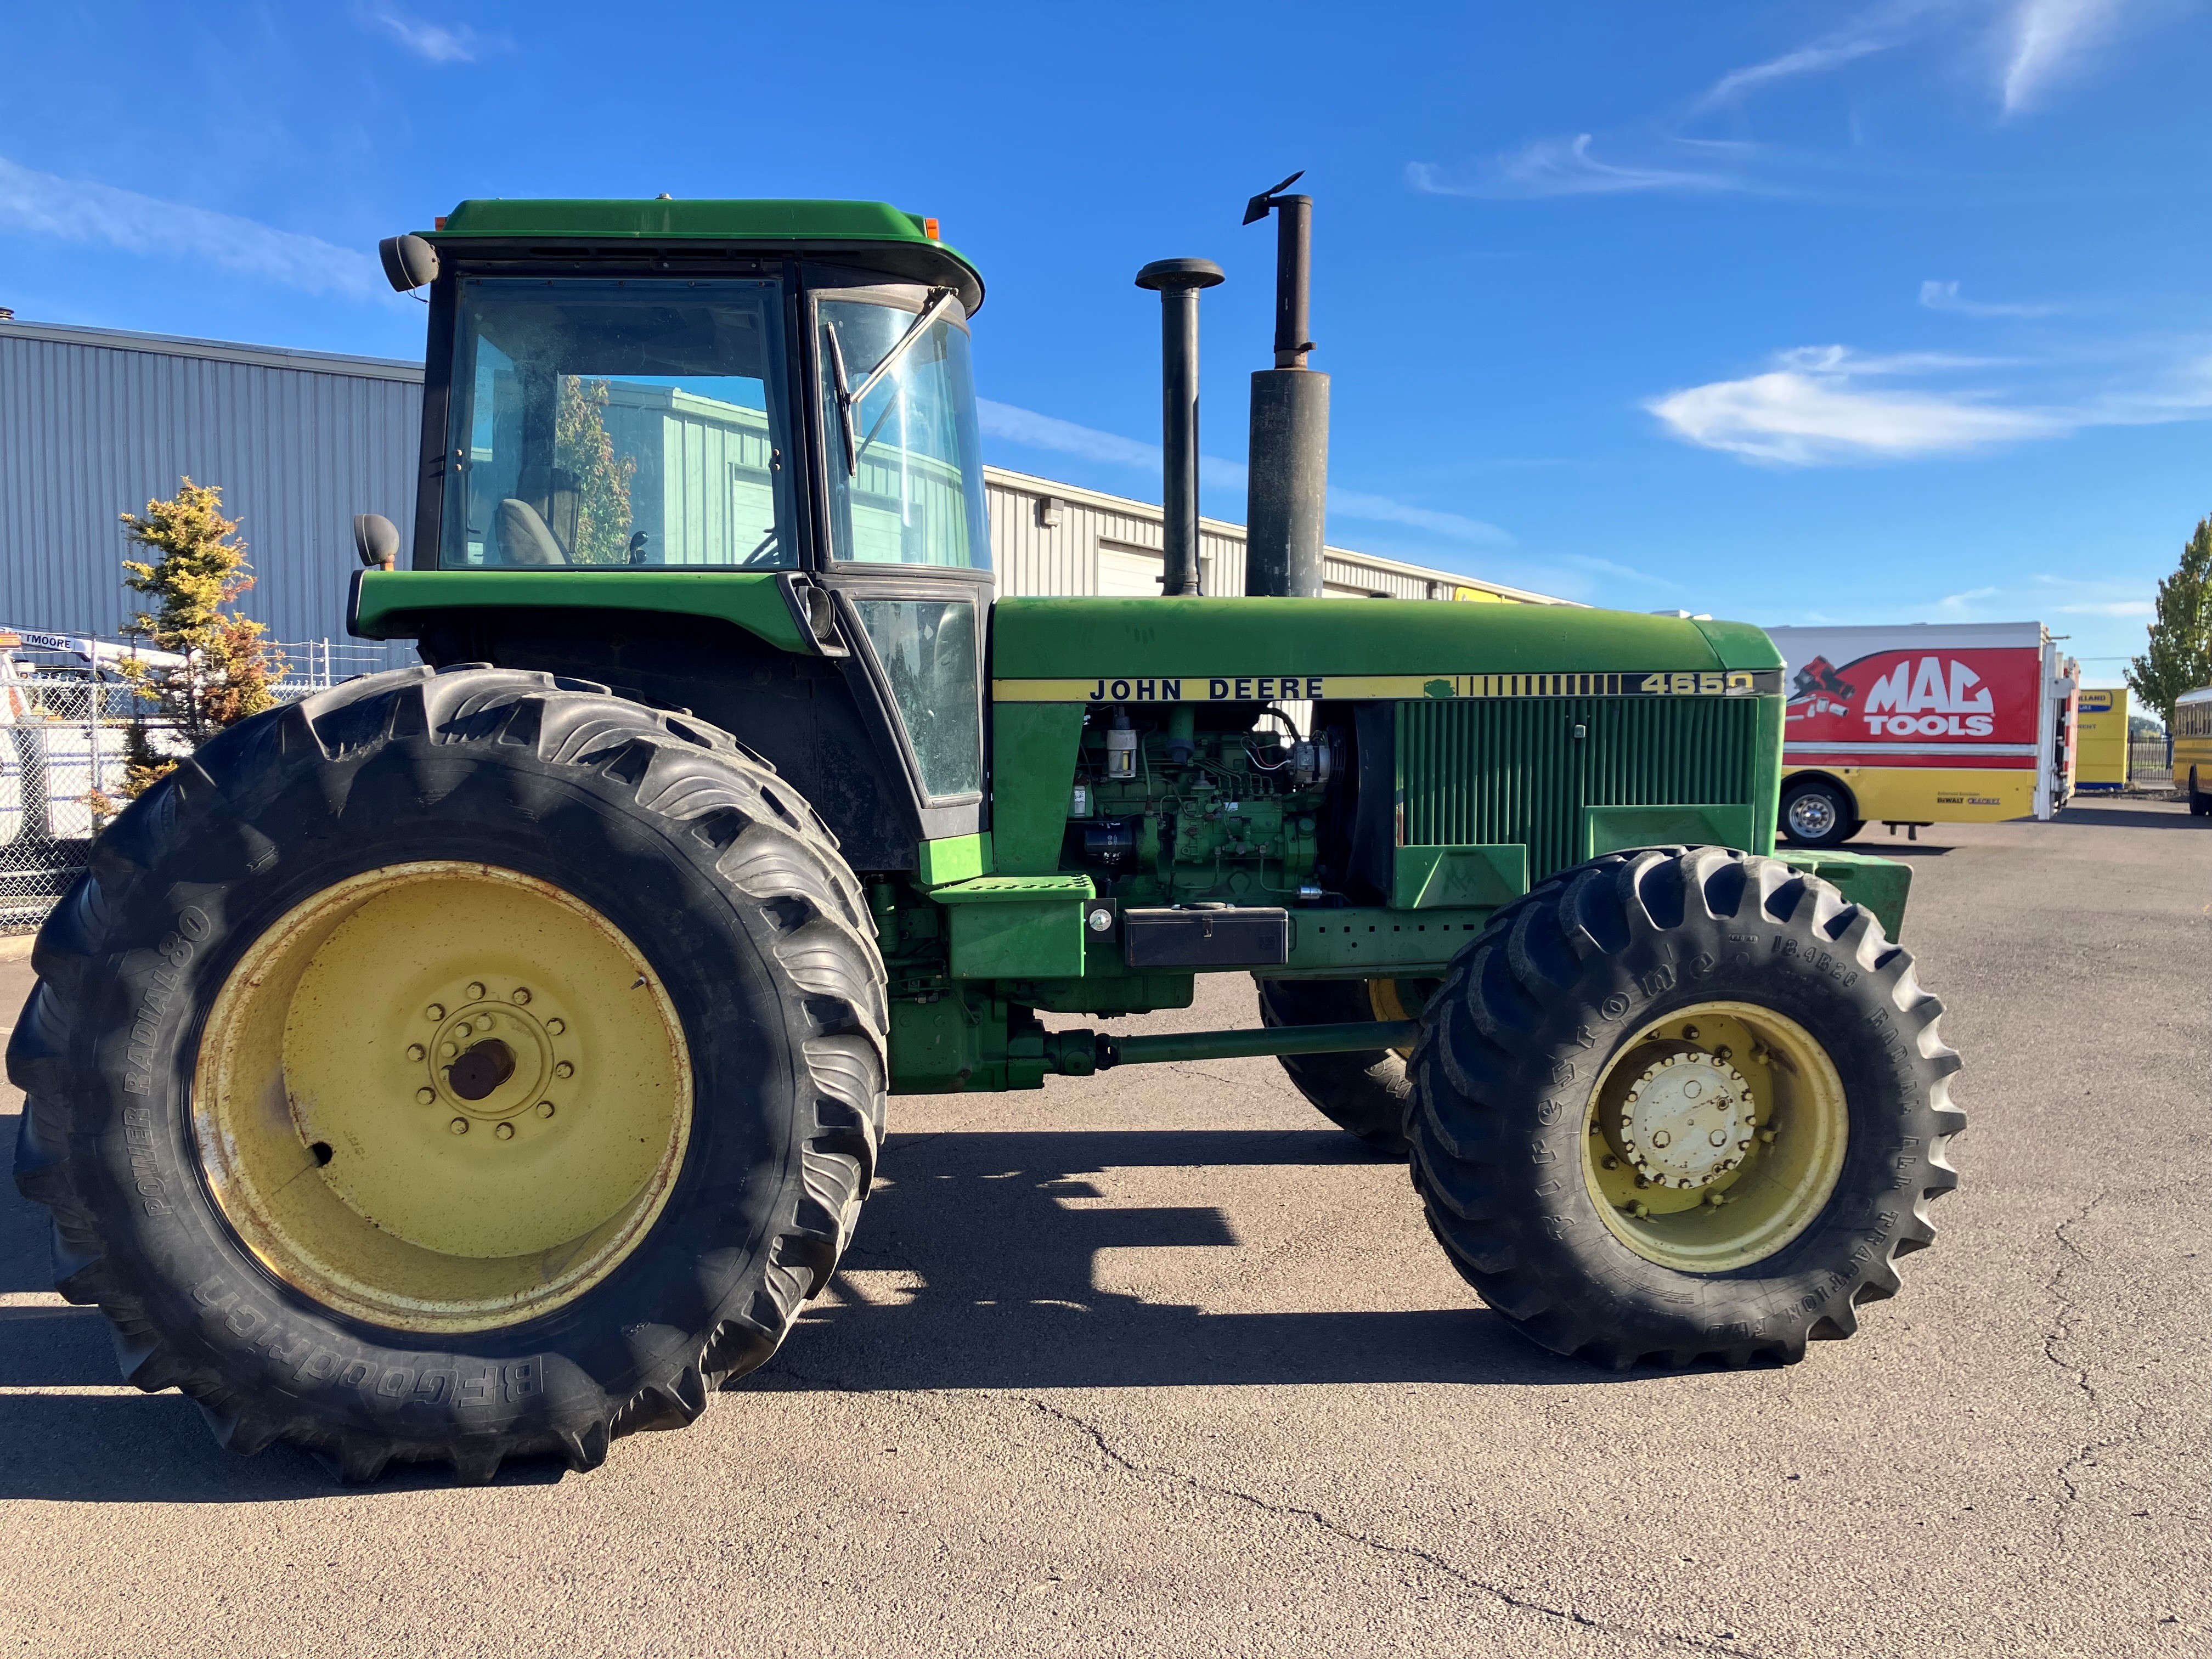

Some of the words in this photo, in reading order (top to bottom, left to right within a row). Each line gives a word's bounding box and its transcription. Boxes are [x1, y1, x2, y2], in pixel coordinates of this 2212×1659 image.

[1090, 679, 1181, 701] JOHN
[1209, 678, 1323, 699] DEERE
[1641, 672, 1754, 695] 4650
[1865, 656, 1994, 713] MAC
[1864, 715, 1994, 736] TOOLS
[159, 905, 211, 968] 80
[124, 970, 178, 1097] RADIAL
[124, 1106, 173, 1218] POWER
